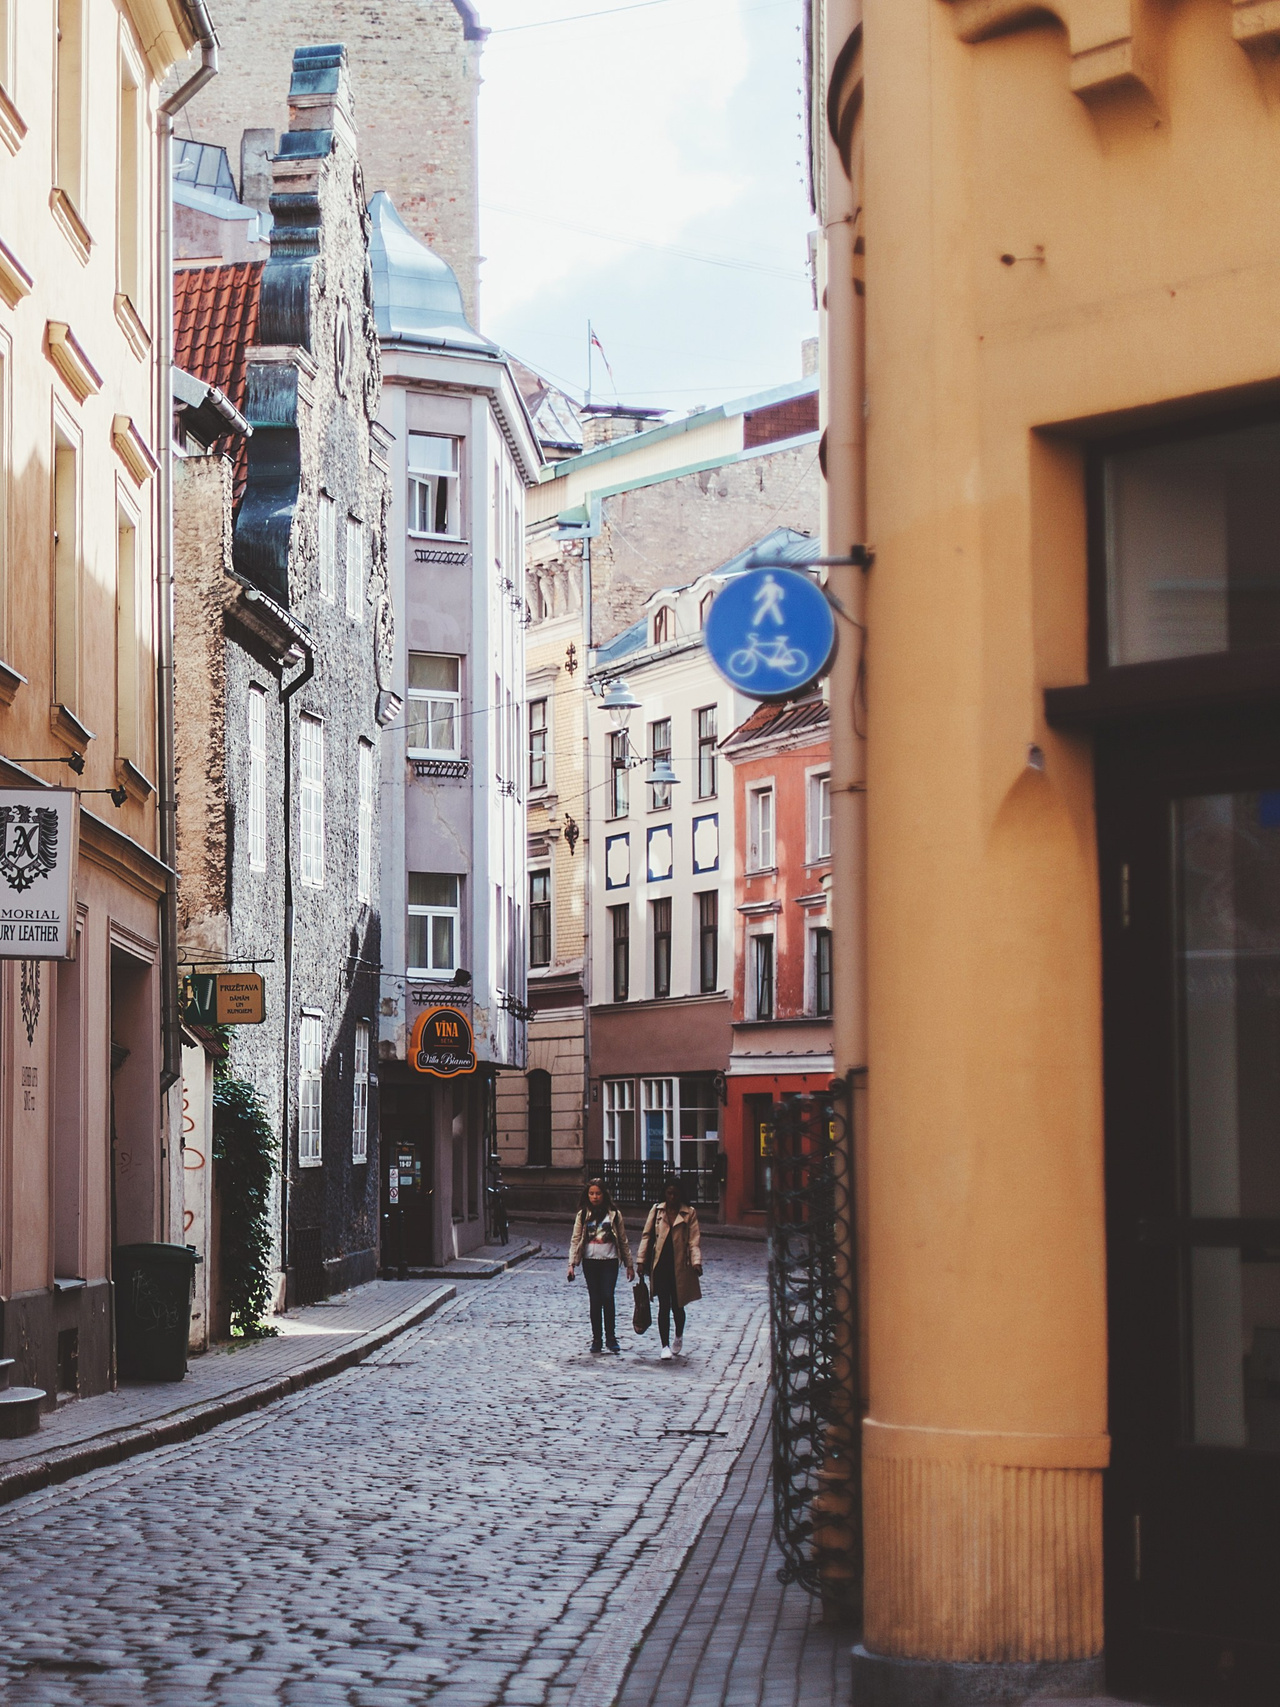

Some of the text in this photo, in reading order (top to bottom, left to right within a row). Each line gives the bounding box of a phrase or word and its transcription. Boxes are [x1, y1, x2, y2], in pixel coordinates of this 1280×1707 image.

[19, 925, 59, 942] LEATHER
[435, 1020, 459, 1037] VĪNA
[422, 1052, 471, 1065] Villa Bianco
